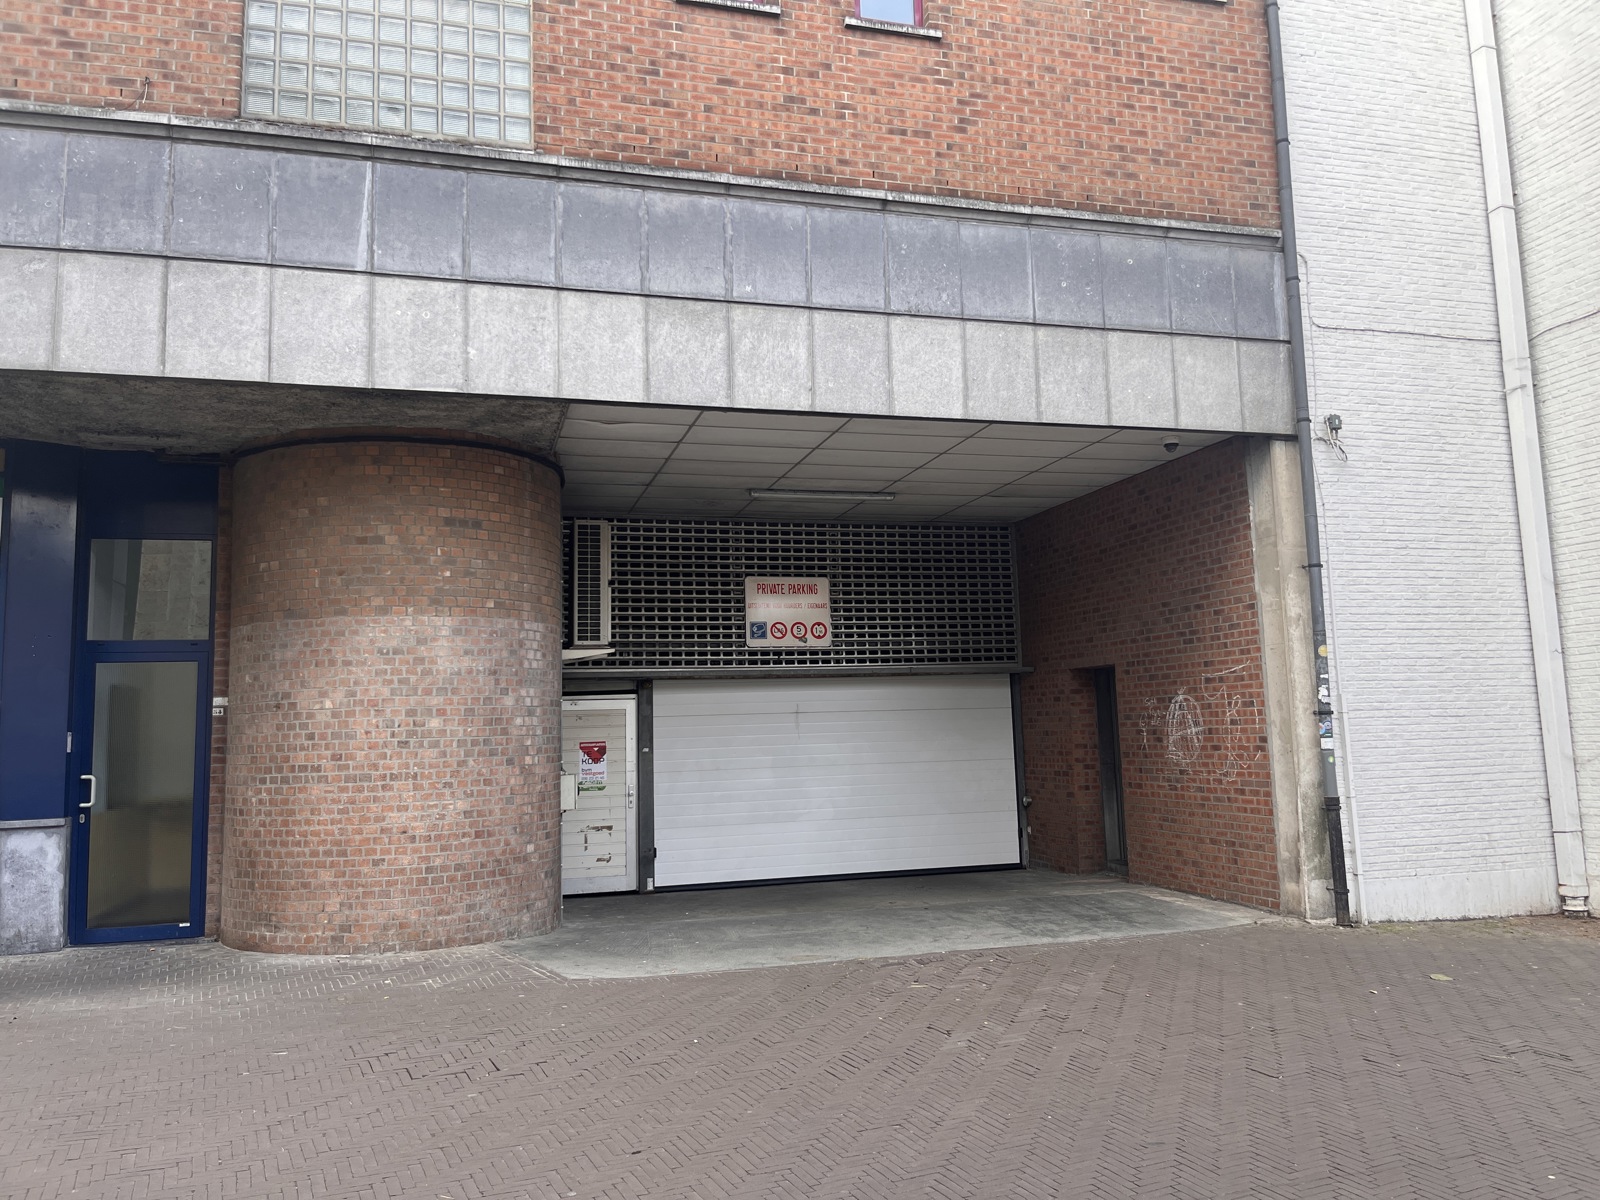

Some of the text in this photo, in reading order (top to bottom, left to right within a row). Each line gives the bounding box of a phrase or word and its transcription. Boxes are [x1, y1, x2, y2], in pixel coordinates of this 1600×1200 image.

[756, 583, 818, 595] PRIVATE PARKING
[796, 625, 802, 633] 5
[581, 757, 605, 765] KOOP
